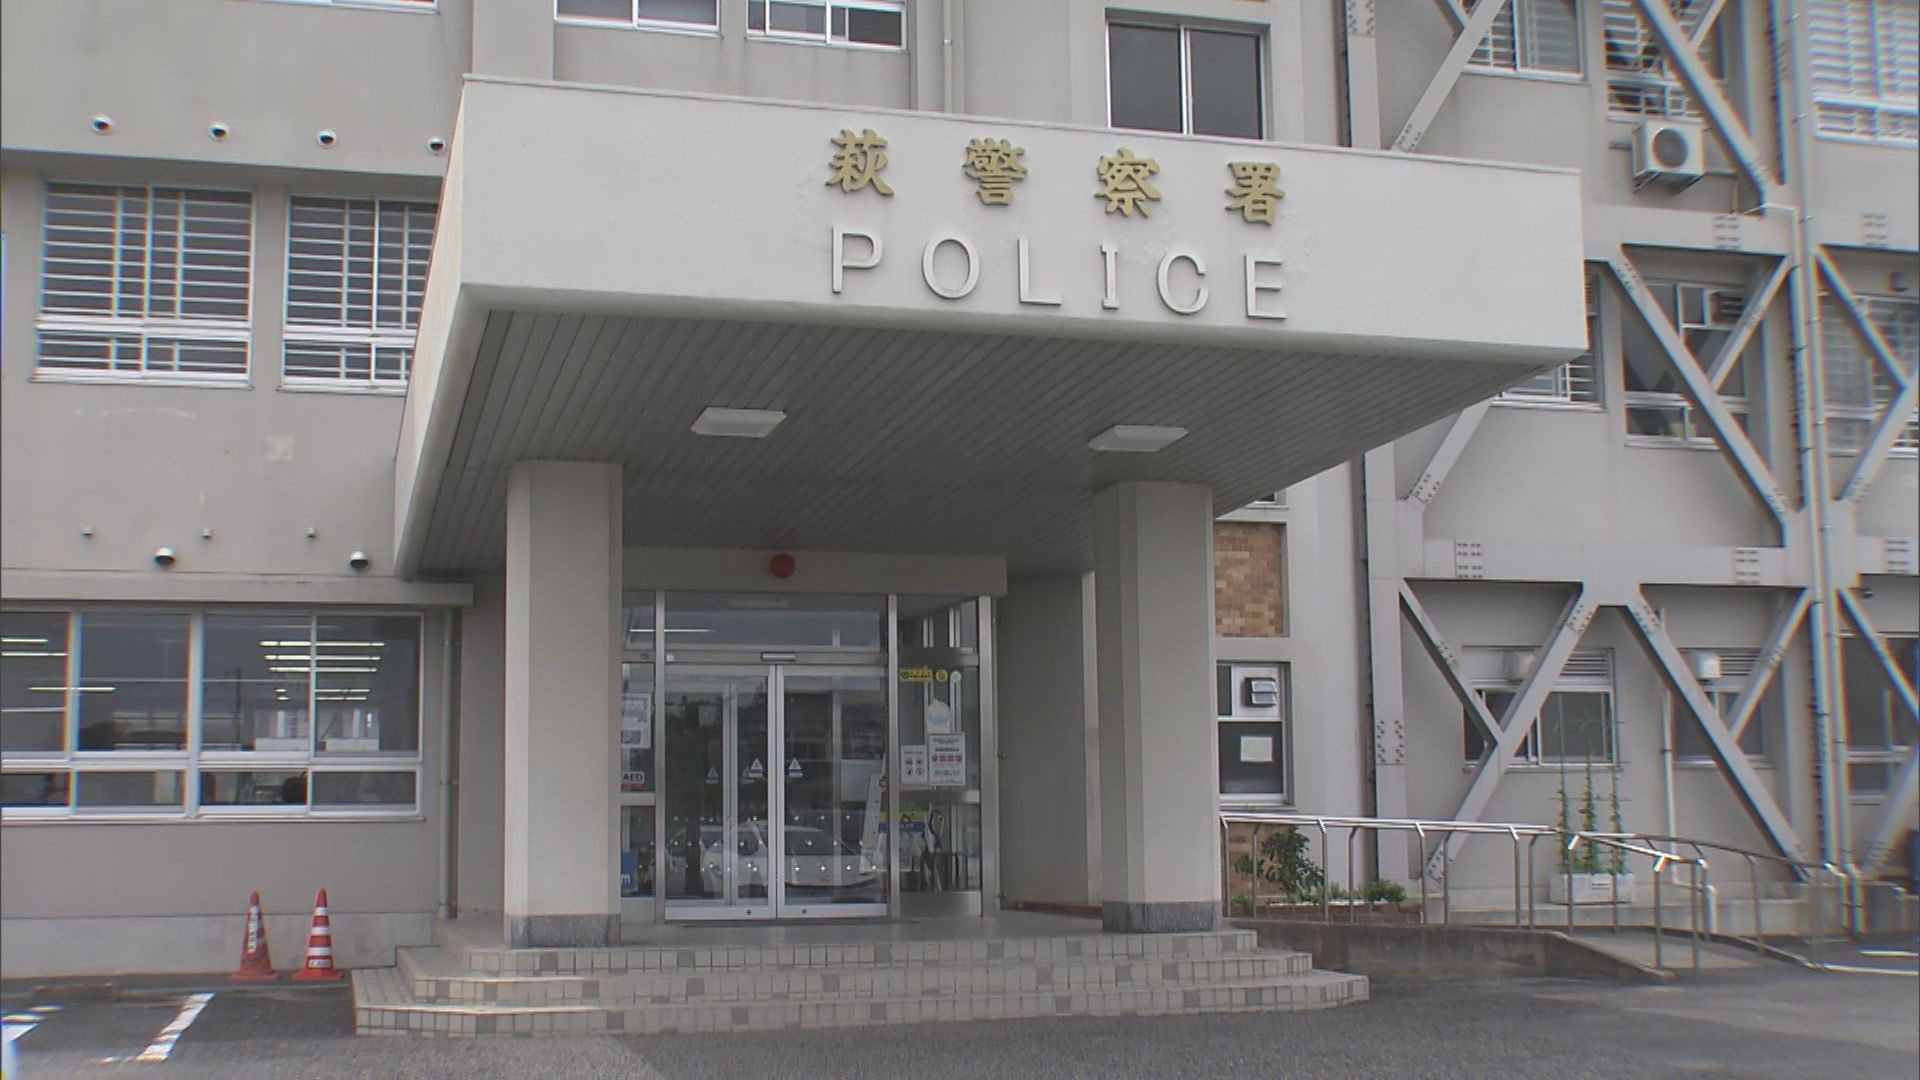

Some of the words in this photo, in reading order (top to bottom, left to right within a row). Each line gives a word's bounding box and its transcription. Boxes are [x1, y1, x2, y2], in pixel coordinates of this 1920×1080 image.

[825, 128, 1286, 226] 萩警察署
[831, 225, 1288, 320] POLICE
